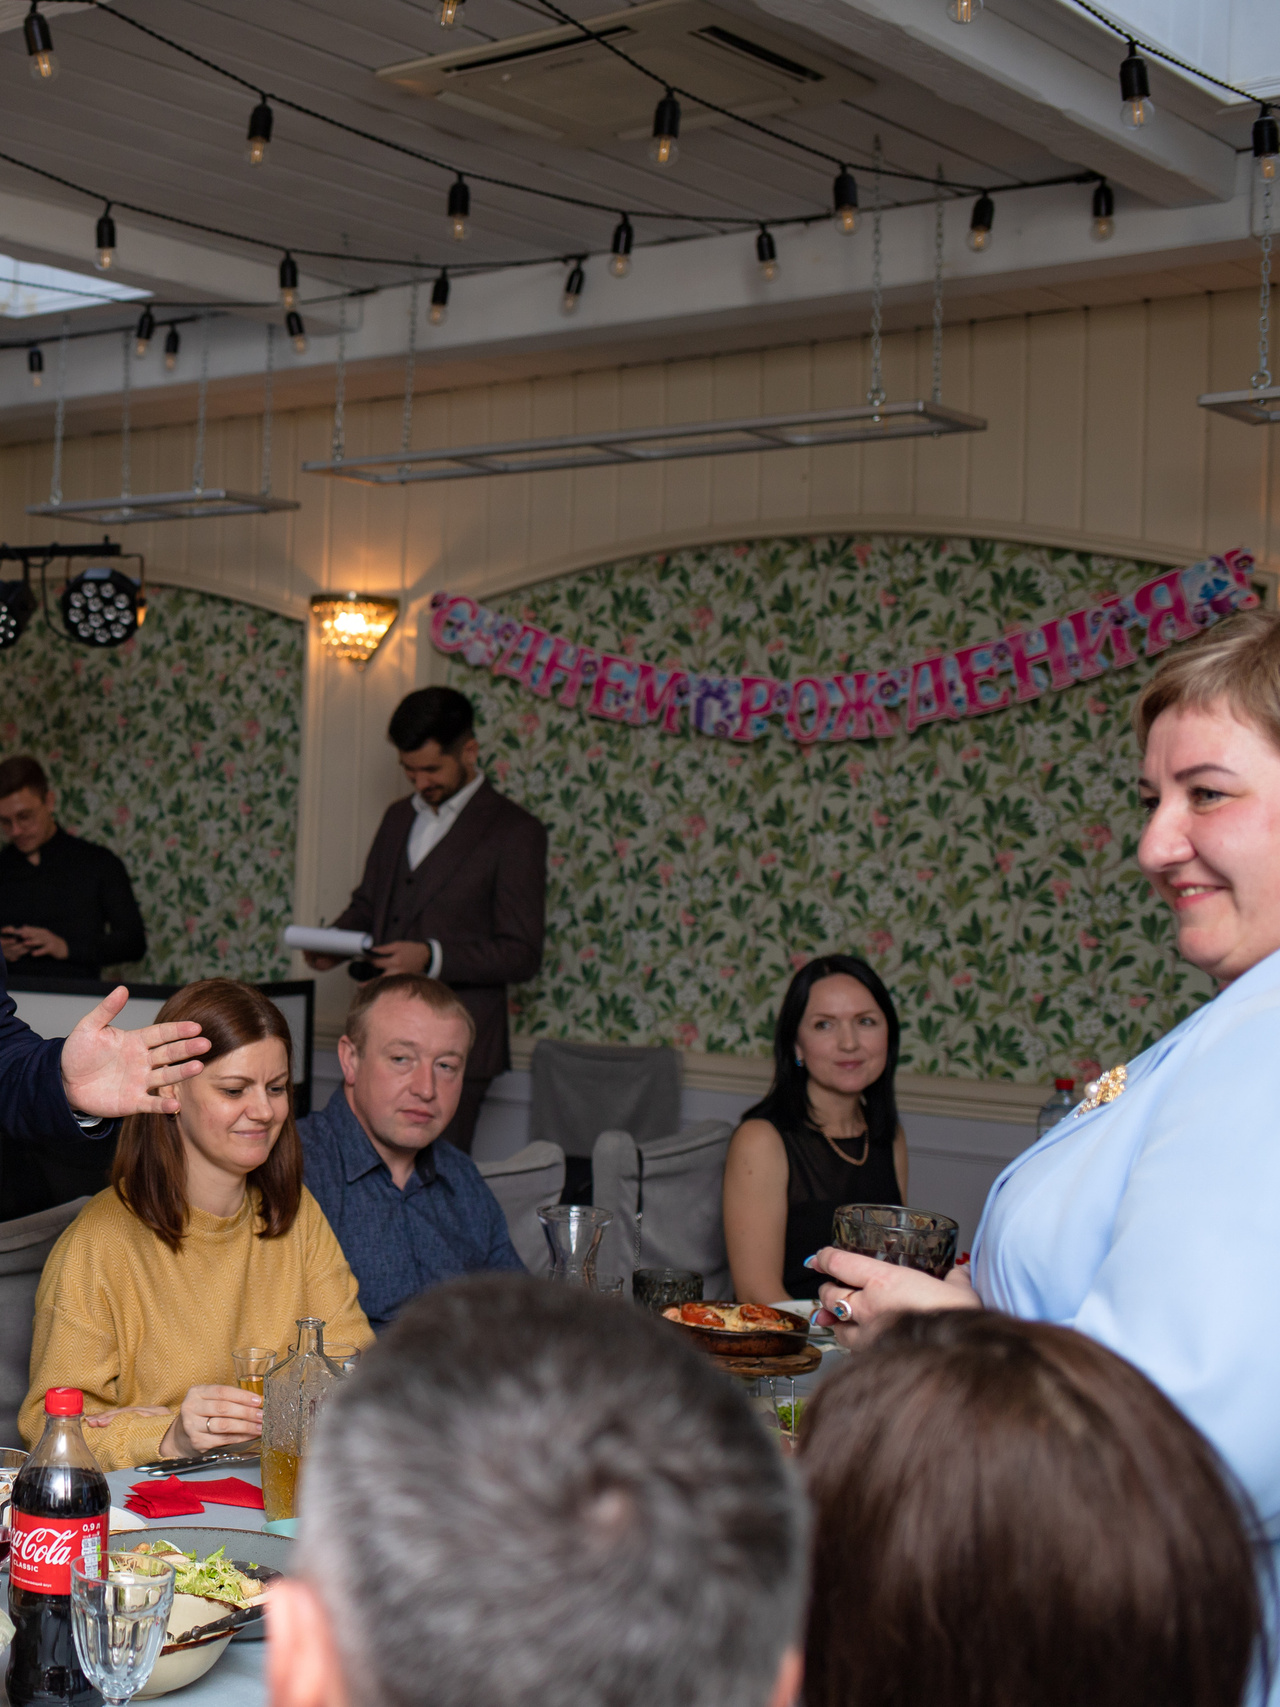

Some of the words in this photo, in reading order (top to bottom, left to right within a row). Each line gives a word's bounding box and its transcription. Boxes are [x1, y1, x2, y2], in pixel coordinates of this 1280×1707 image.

[430, 596, 480, 653] С
[492, 622, 688, 734] ДНЕМ
[82, 1522, 95, 1533] 0,9
[13, 1559, 39, 1573] CLASSIC
